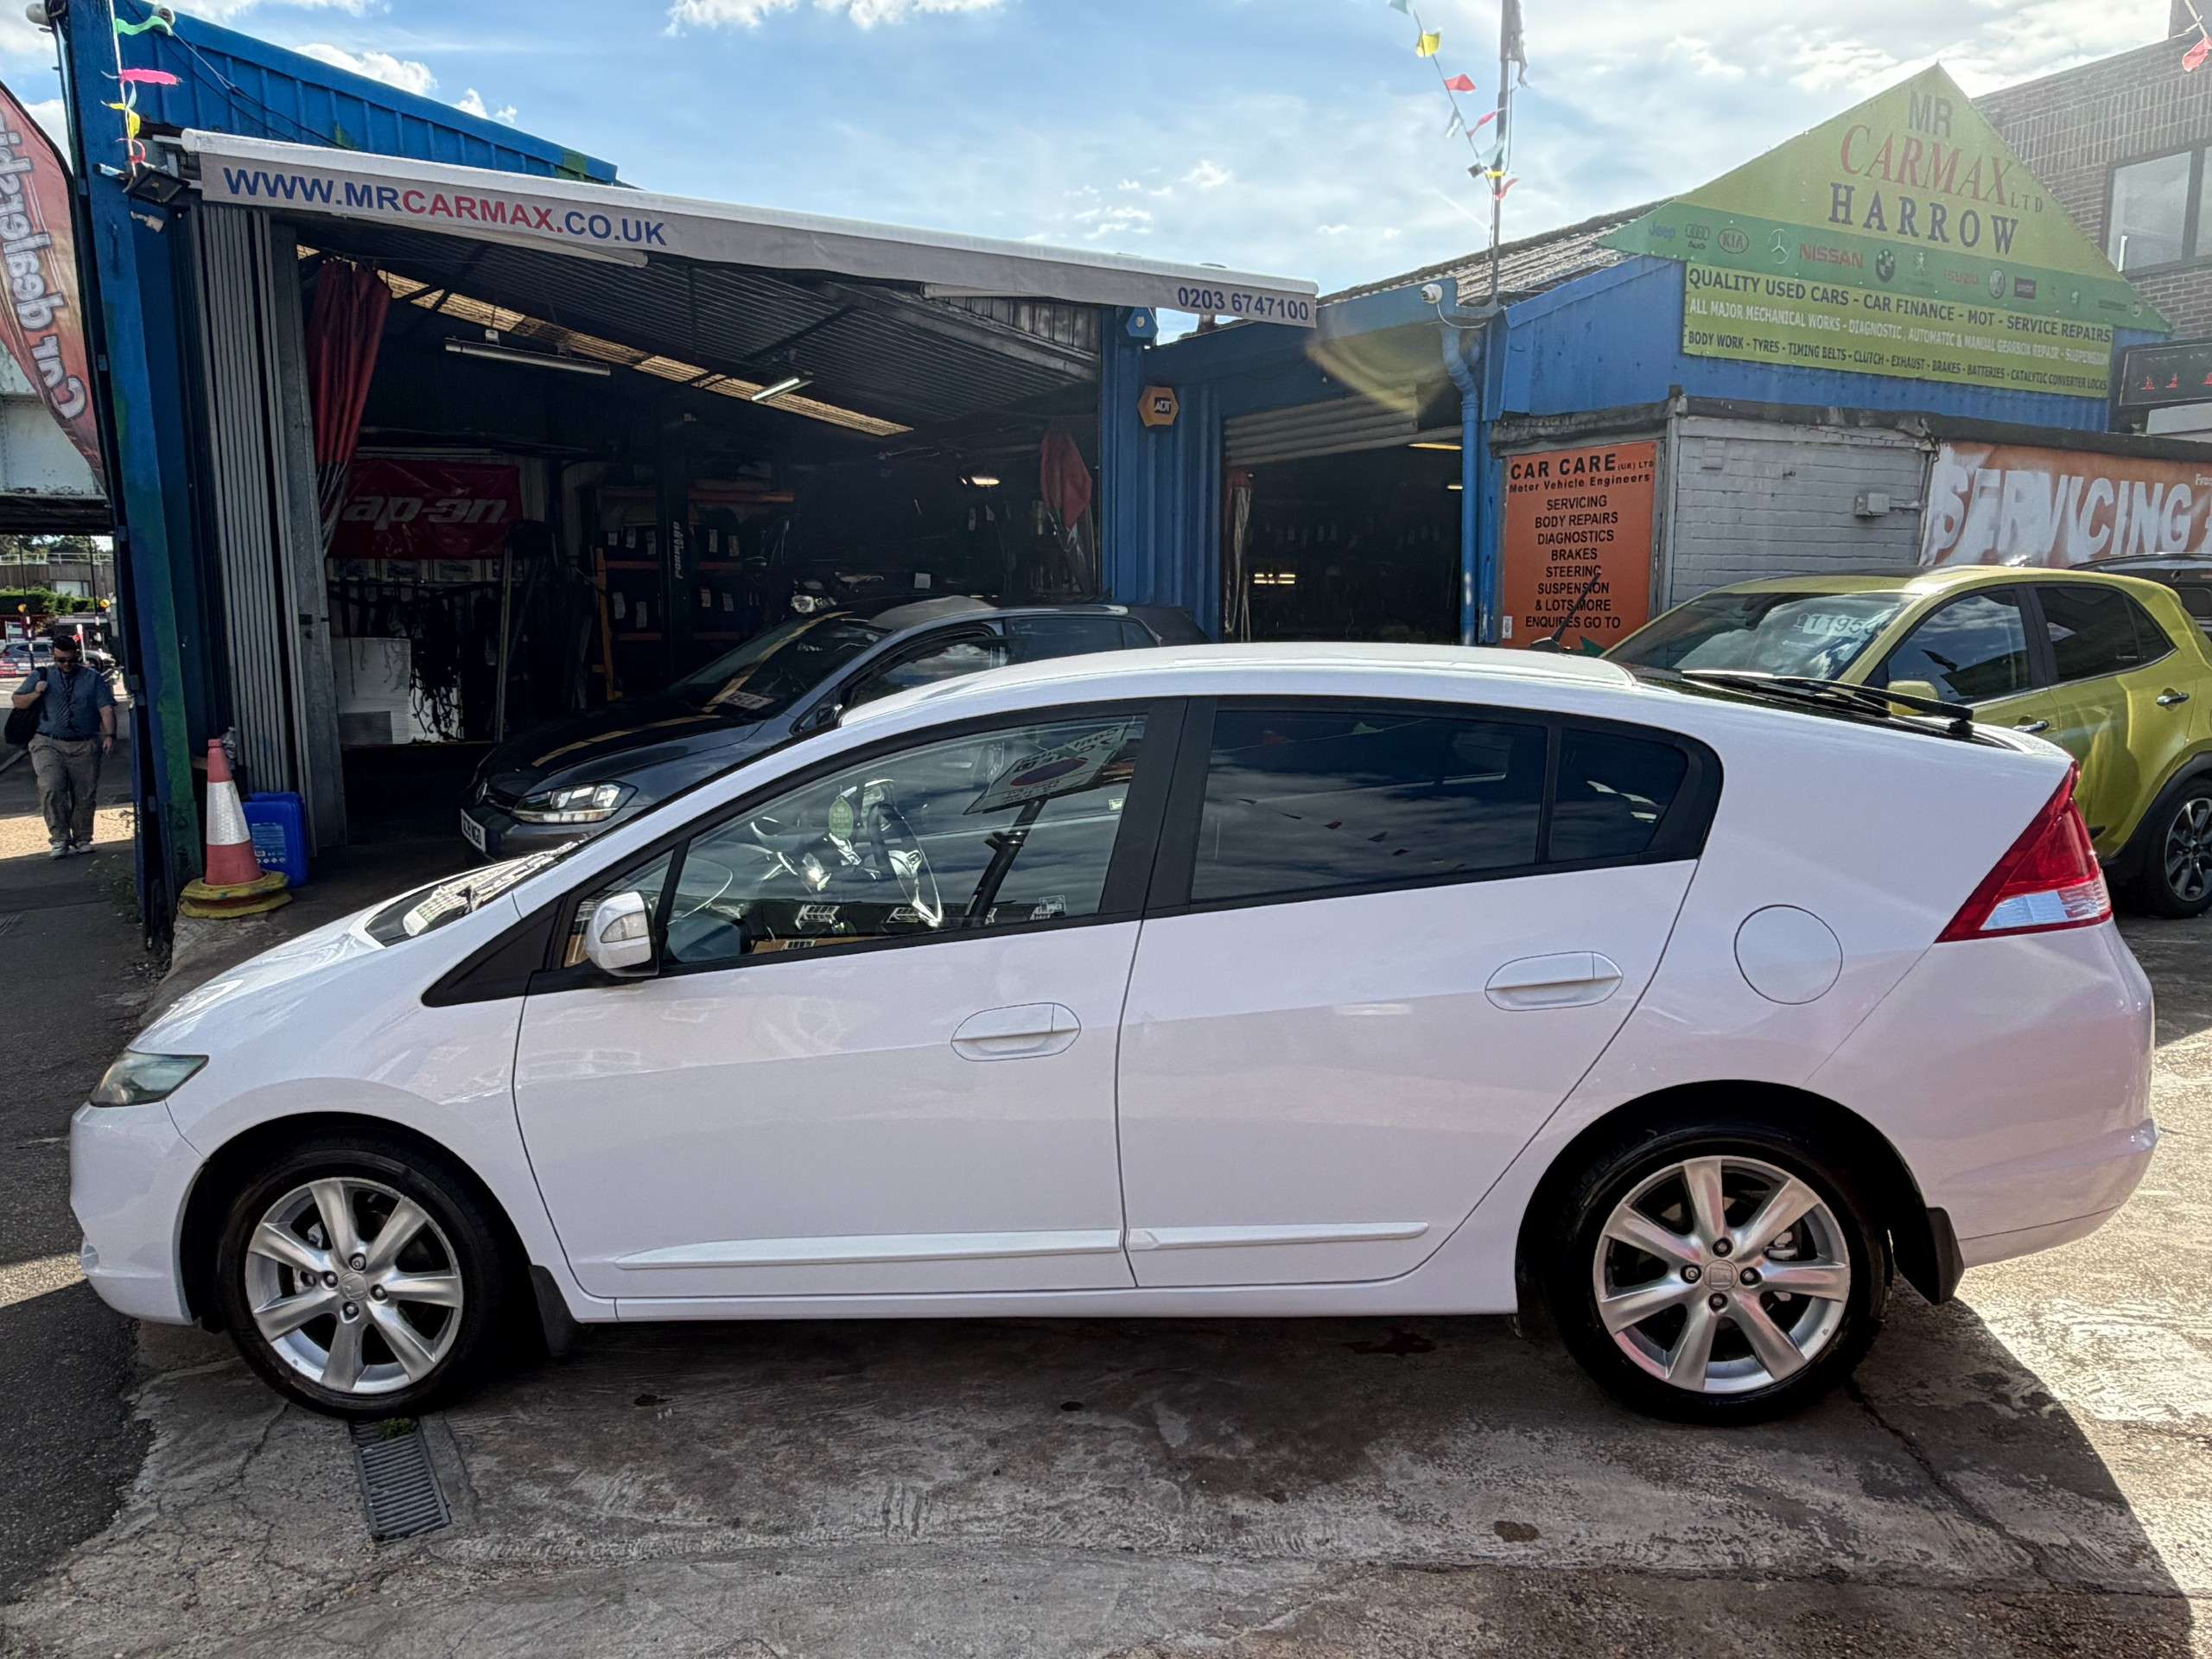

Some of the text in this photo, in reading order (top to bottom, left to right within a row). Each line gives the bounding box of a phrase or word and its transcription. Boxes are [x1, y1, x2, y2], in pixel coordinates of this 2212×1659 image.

[1908, 89, 1953, 138] MR
[1840, 124, 2043, 213] CARMAX LTD
[223, 167, 667, 246] WWW.MRCARMAX.CO.UK
[1828, 182, 2019, 255] HARROW
[1800, 243, 1864, 270] NISSAN
[1178, 286, 1309, 321] 0203 6747100
[1689, 268, 1761, 293] QUALITY
[1765, 279, 1806, 299] USED
[1811, 286, 1849, 306] CARS
[1864, 294, 1891, 312] CAR
[1896, 299, 1955, 321] FINANCE
[1967, 309, 1995, 326] MOT
[2007, 315, 2058, 336] SERVICE
[2061, 324, 2111, 342] REPAIRS
[1689, 298, 1707, 315] ALL
[1710, 300, 1744, 320] MAJOR
[1745, 305, 1806, 327] MECHANICAL
[1808, 313, 1841, 332] WORKS
[1908, 328, 1956, 347] AUTOMATIC
[1688, 331, 1713, 346] BODY
[1717, 334, 1744, 349] WORK
[1753, 338, 1780, 353] TYRES
[1789, 342, 1820, 359] TIMING
[1822, 346, 1847, 361] BELTS
[1854, 351, 1885, 365] CLUTCH
[1891, 354, 1925, 370] EXHAUST
[1932, 360, 1961, 374] BRAKES
[1967, 364, 2005, 379] BATTERIES
[1154, 400, 1172, 413] ADT
[1511, 461, 1549, 480] CAR
[1559, 454, 1617, 475] CARE
[1638, 460, 1654, 469] LTD
[1510, 474, 1650, 493] Motor Vehicle Engineers
[1547, 494, 1607, 511] SERVICING
[1535, 512, 1618, 529] BODY REPAIRS
[1537, 529, 1614, 545] DIAGNOSTICS
[1551, 548, 1598, 561] BRAKES
[1546, 565, 1601, 578] STEERING
[1535, 599, 1611, 612] & LOTS MORE
[1584, 616, 1602, 628] GO
[1605, 616, 1621, 628] TO
